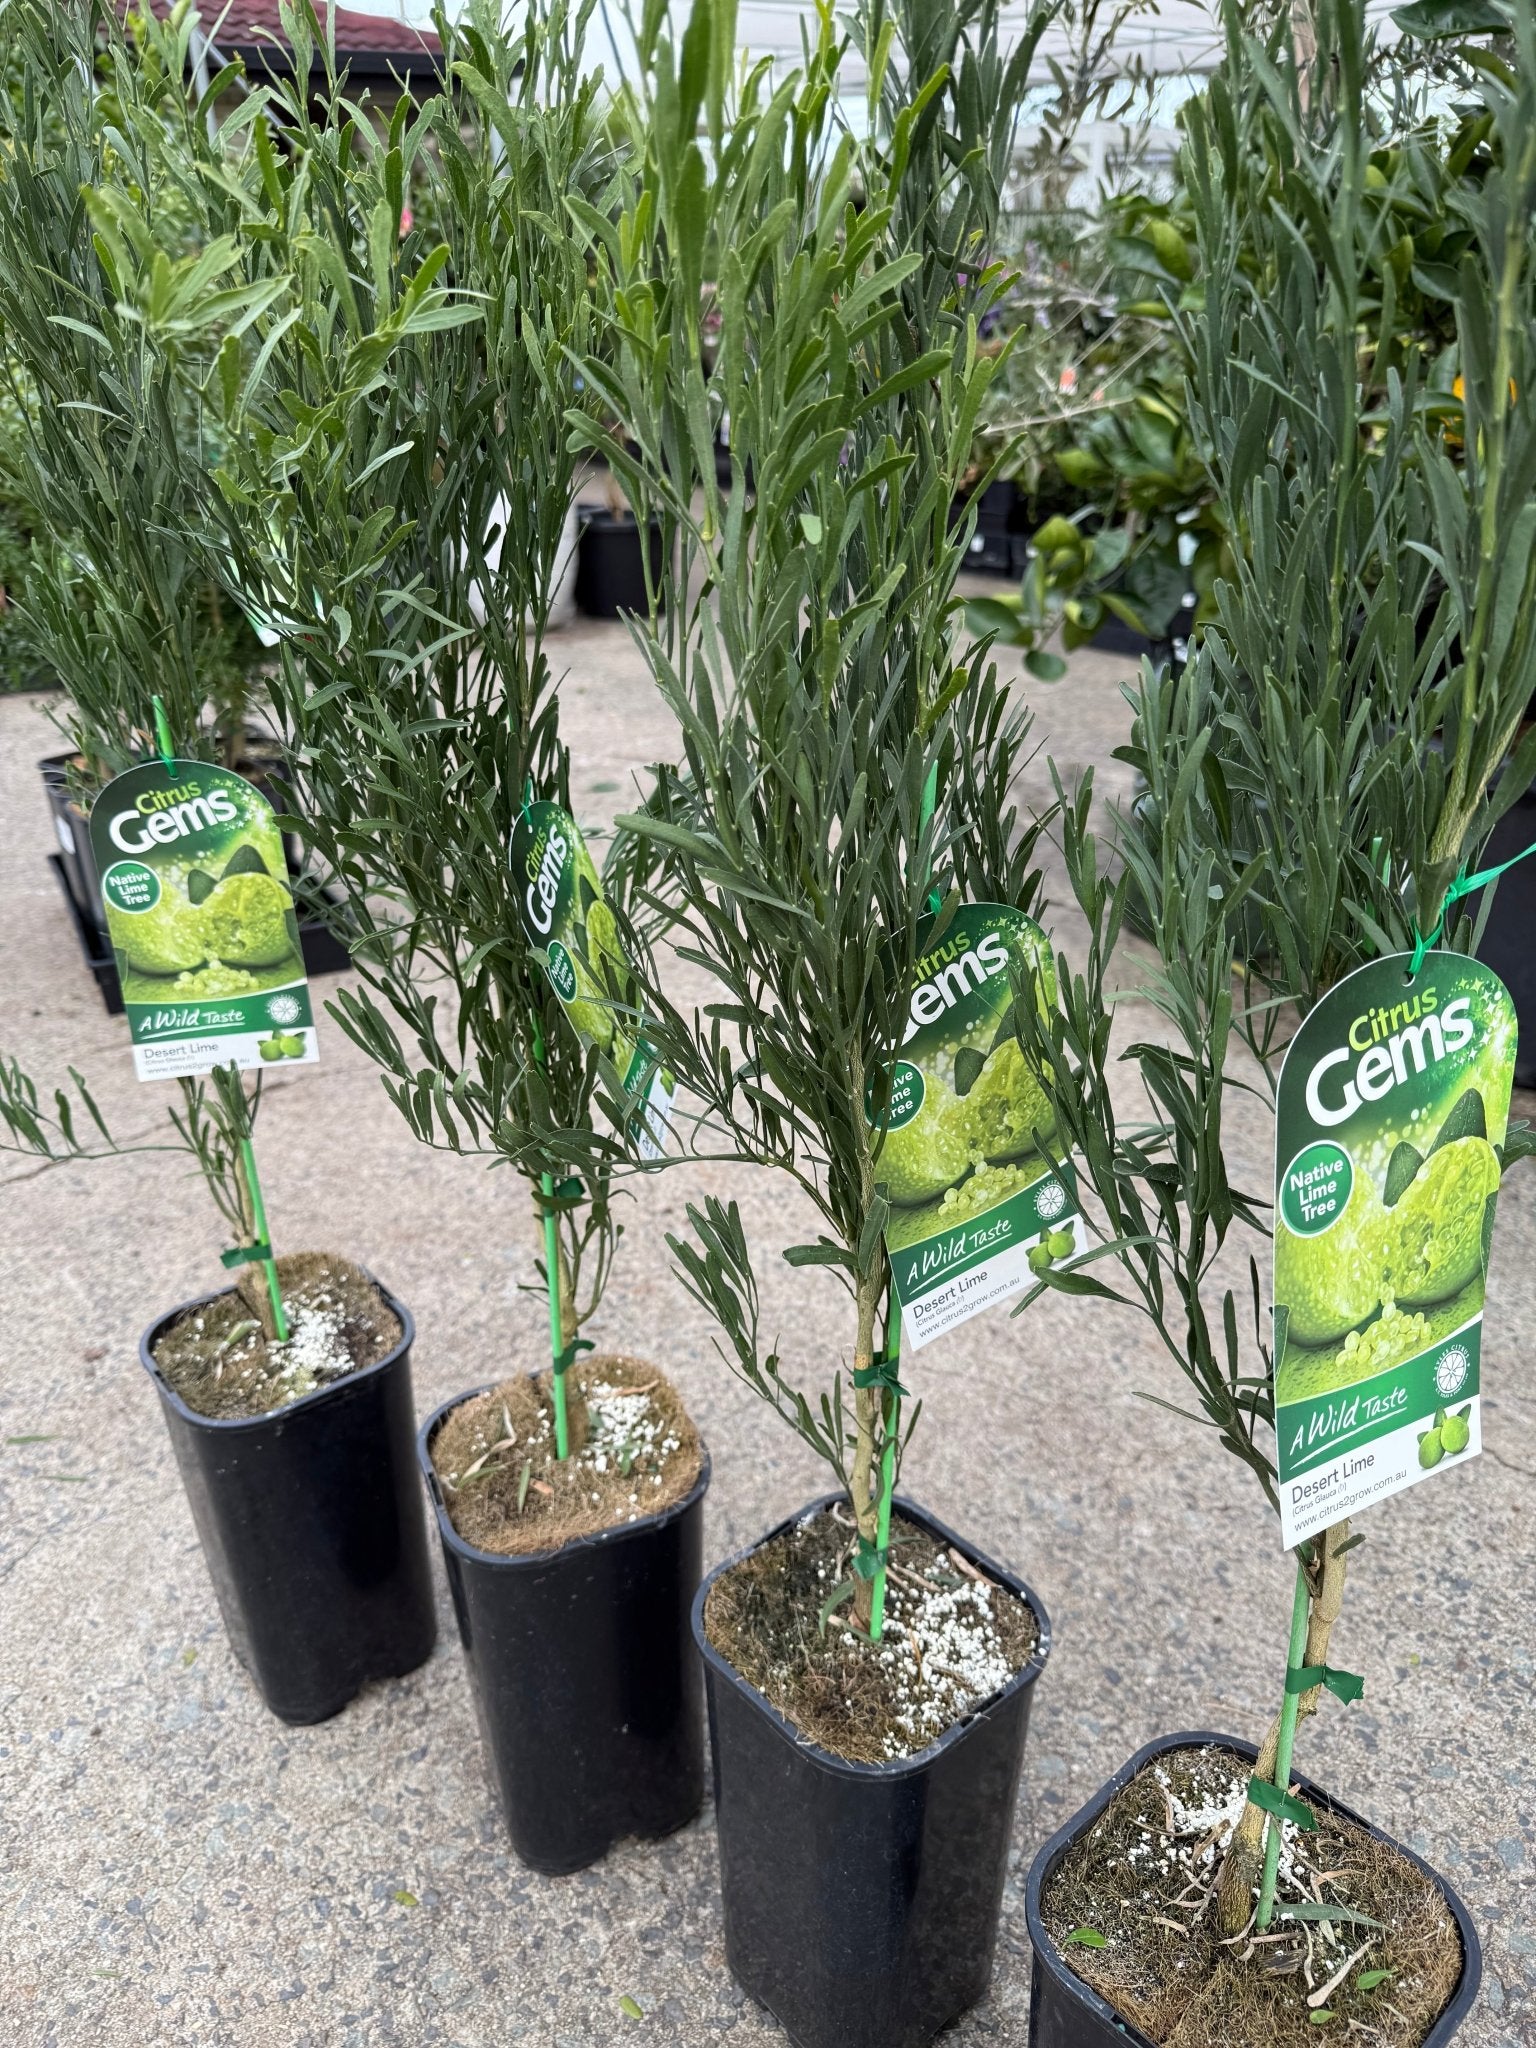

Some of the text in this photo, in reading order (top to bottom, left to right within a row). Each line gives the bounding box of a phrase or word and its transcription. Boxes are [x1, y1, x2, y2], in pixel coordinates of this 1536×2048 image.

[135, 781, 202, 814] Citrus
[109, 789, 238, 854] Gems
[525, 826, 547, 883] Citrus
[108, 871, 151, 887] Native
[118, 883, 149, 897] Lime
[526, 823, 567, 935] Gems
[122, 893, 151, 906] Tree
[551, 948, 564, 979] Native
[558, 962, 569, 985] Lime
[911, 931, 971, 991] itrus
[563, 972, 574, 993] Tree
[138, 1016, 151, 1033] A
[155, 1008, 200, 1029] Wild
[201, 1009, 246, 1025] Taste
[1348, 986, 1438, 1052] Citrus
[144, 1042, 219, 1059] Desert Lime
[1305, 997, 1474, 1127] Gems
[889, 1100, 914, 1121] ree
[1290, 1159, 1344, 1192] Native
[1299, 1180, 1337, 1207] Lime
[1301, 1199, 1337, 1222] Tree
[906, 1219, 1012, 1286] A Wild Taste
[913, 1271, 988, 1320] Desert Lime
[919, 1276, 1020, 1338] www.citrus2grow.com.au
[1289, 1424, 1304, 1457] A
[1307, 1394, 1360, 1446] Wild
[1361, 1385, 1409, 1420] Taste
[1291, 1454, 1375, 1505] Desert Lime
[1292, 1489, 1337, 1517] (Citrus Glauca
[1294, 1469, 1408, 1532] www.citrus2grow.com.au
